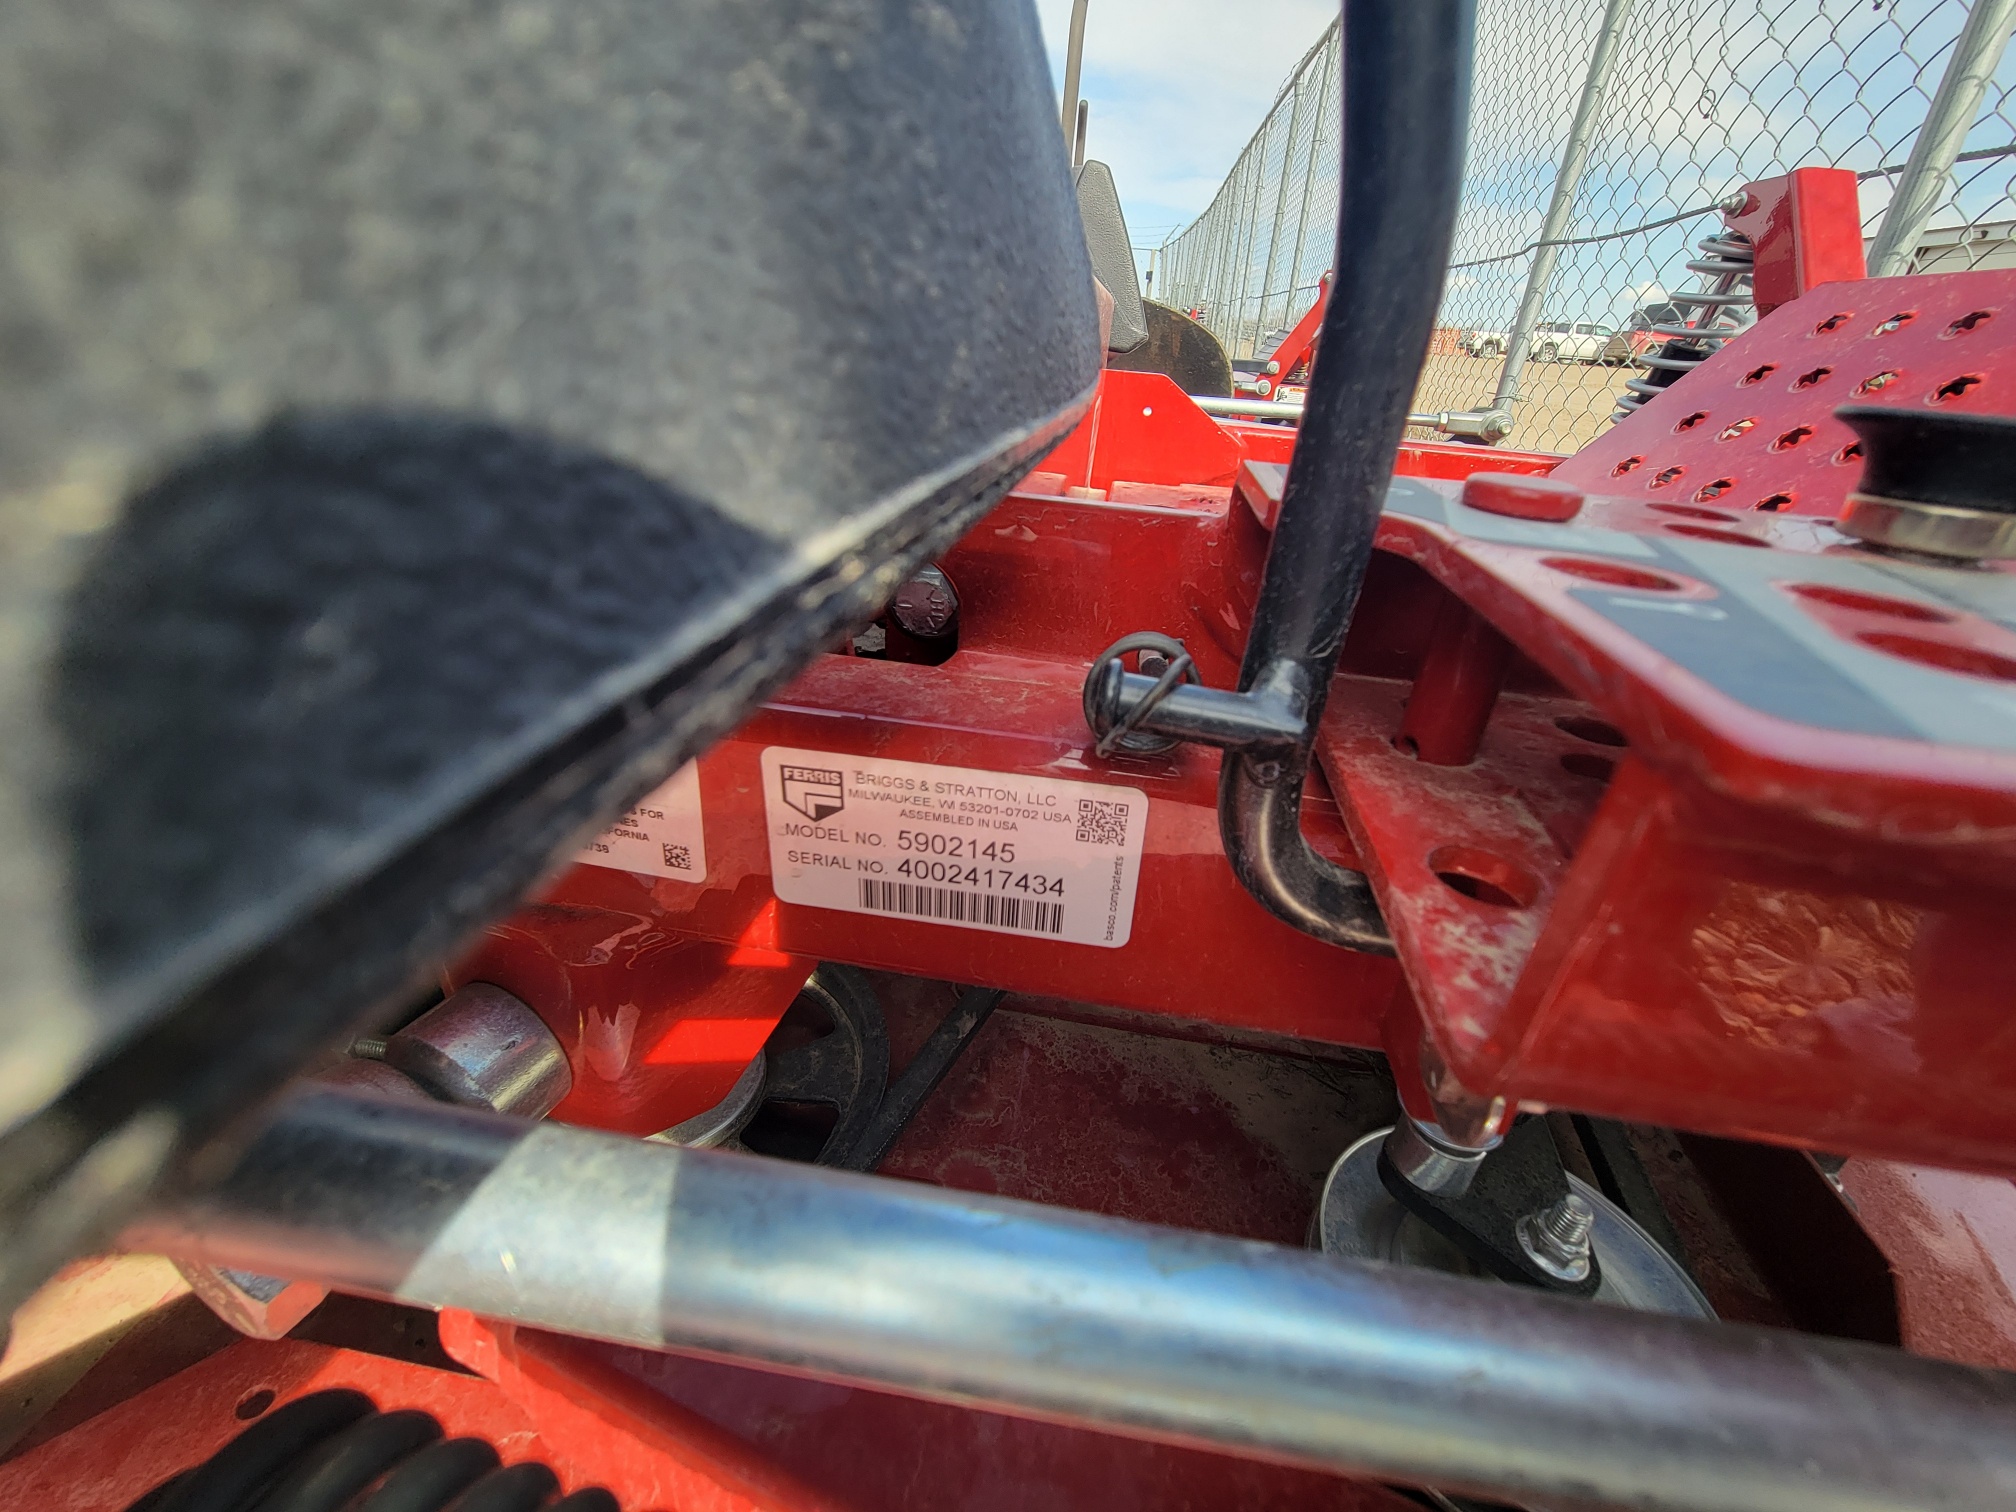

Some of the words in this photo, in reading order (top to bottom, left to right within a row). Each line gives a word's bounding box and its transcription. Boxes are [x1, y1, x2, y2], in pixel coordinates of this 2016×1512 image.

[784, 767, 841, 785] FERRIS
[855, 771, 915, 790] BRIGGS
[919, 780, 930, 792] &
[934, 782, 1021, 804] STRATTON,
[1027, 792, 1057, 807] LLC
[640, 808, 664, 820] FOR
[848, 788, 935, 808] MILWAUKEE,
[939, 799, 956, 810] WI
[959, 801, 1039, 820] 53201-0702
[1043, 812, 1072, 824] USA
[899, 808, 975, 826] ASSEMBLED
[978, 817, 990, 828] IN
[993, 819, 1019, 832] USA
[785, 823, 850, 843] MODEL
[855, 831, 887, 848] NO.
[897, 829, 1015, 863] 5902145
[787, 850, 852, 870] SERIAL
[857, 858, 888, 875] NO.
[897, 858, 1065, 897] 4002417434
[1104, 856, 1124, 941] basco.com/patents
